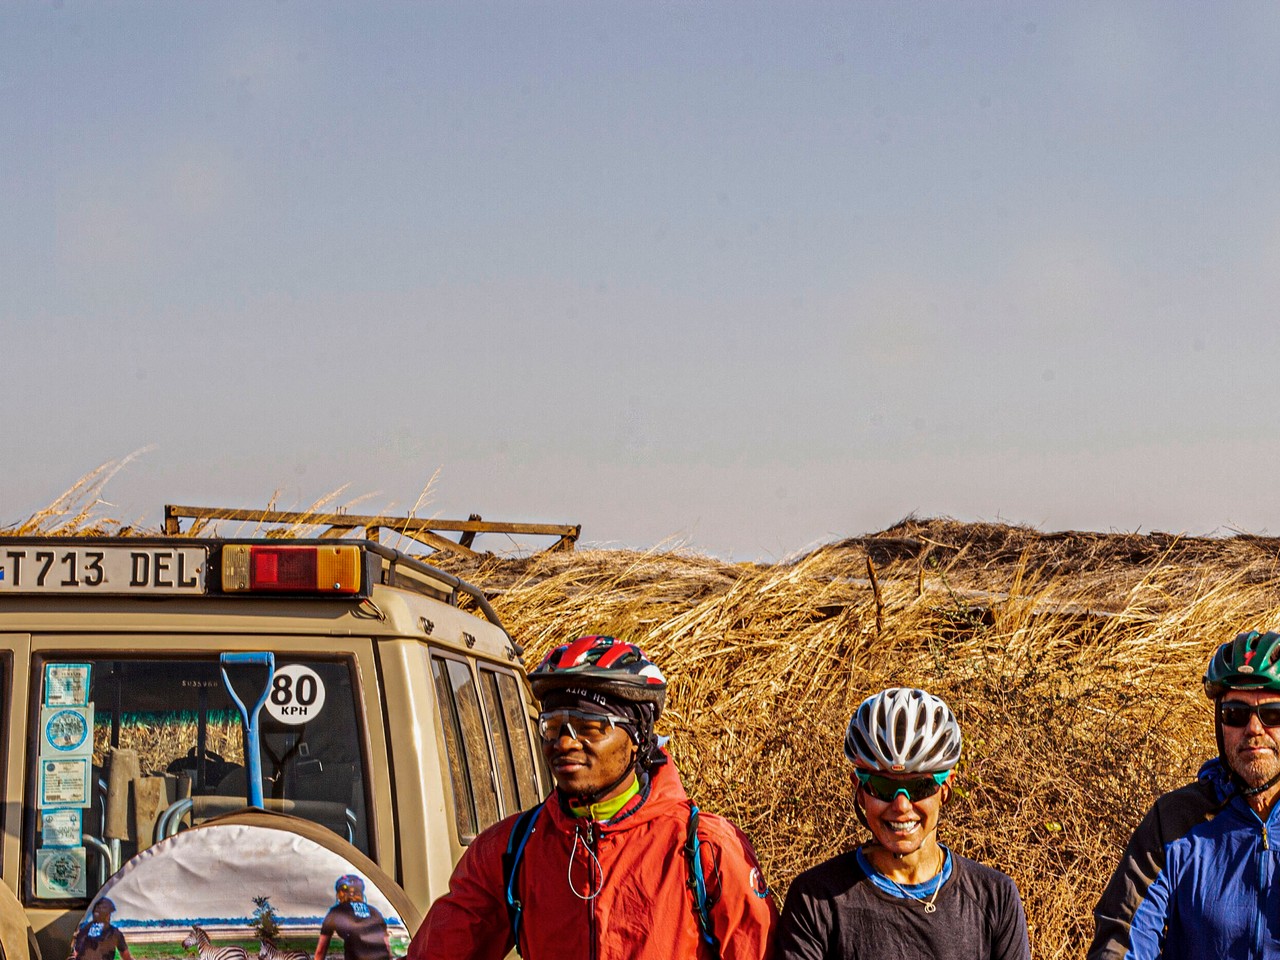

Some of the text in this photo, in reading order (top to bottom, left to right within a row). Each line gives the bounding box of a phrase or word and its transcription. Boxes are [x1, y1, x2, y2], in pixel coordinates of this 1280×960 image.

[129, 551, 197, 588] DEL
[270, 673, 318, 706] 80
[281, 706, 307, 715] KPH
